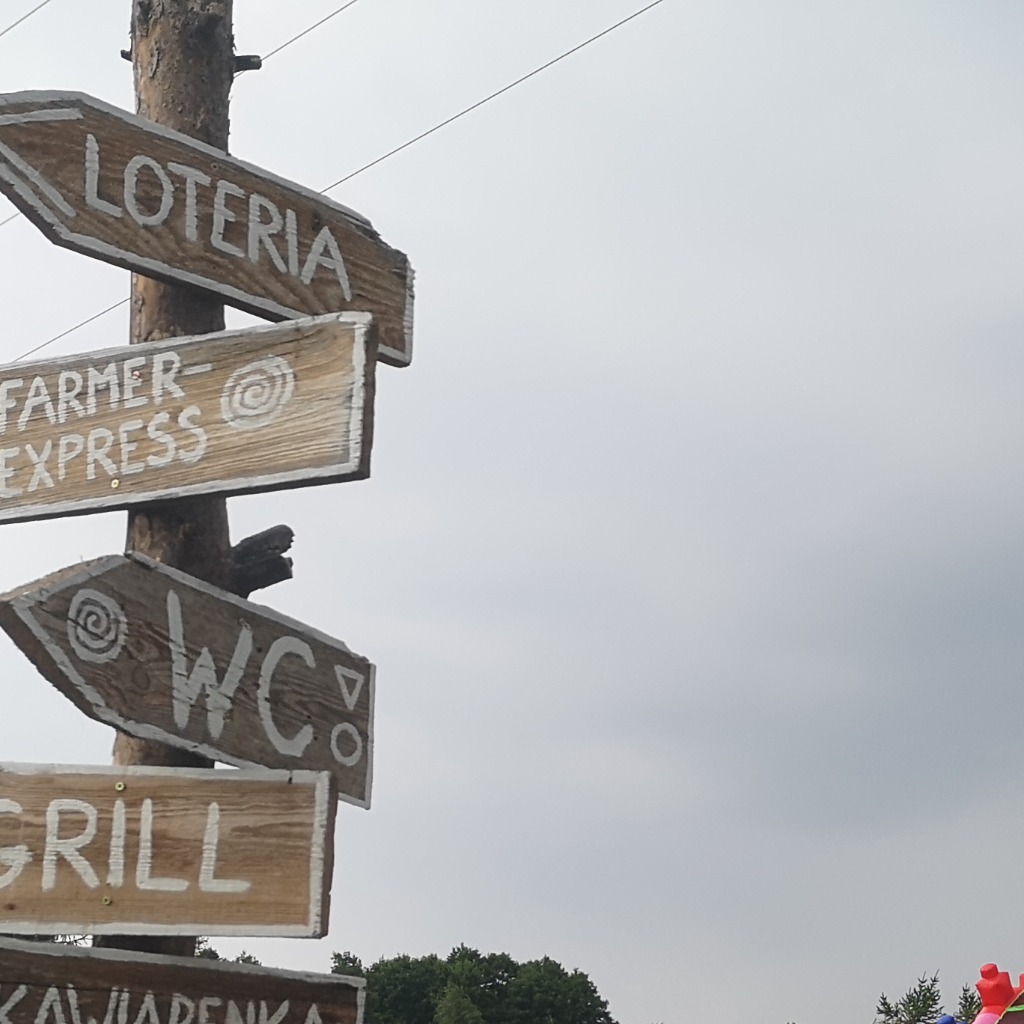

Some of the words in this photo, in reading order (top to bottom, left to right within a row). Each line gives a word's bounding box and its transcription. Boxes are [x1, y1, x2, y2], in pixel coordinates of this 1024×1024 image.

[85, 133, 352, 301] LOTERIA
[0, 406, 207, 498] EXPRESS
[167, 588, 316, 758] WC
[0, 797, 252, 892] GRILL
